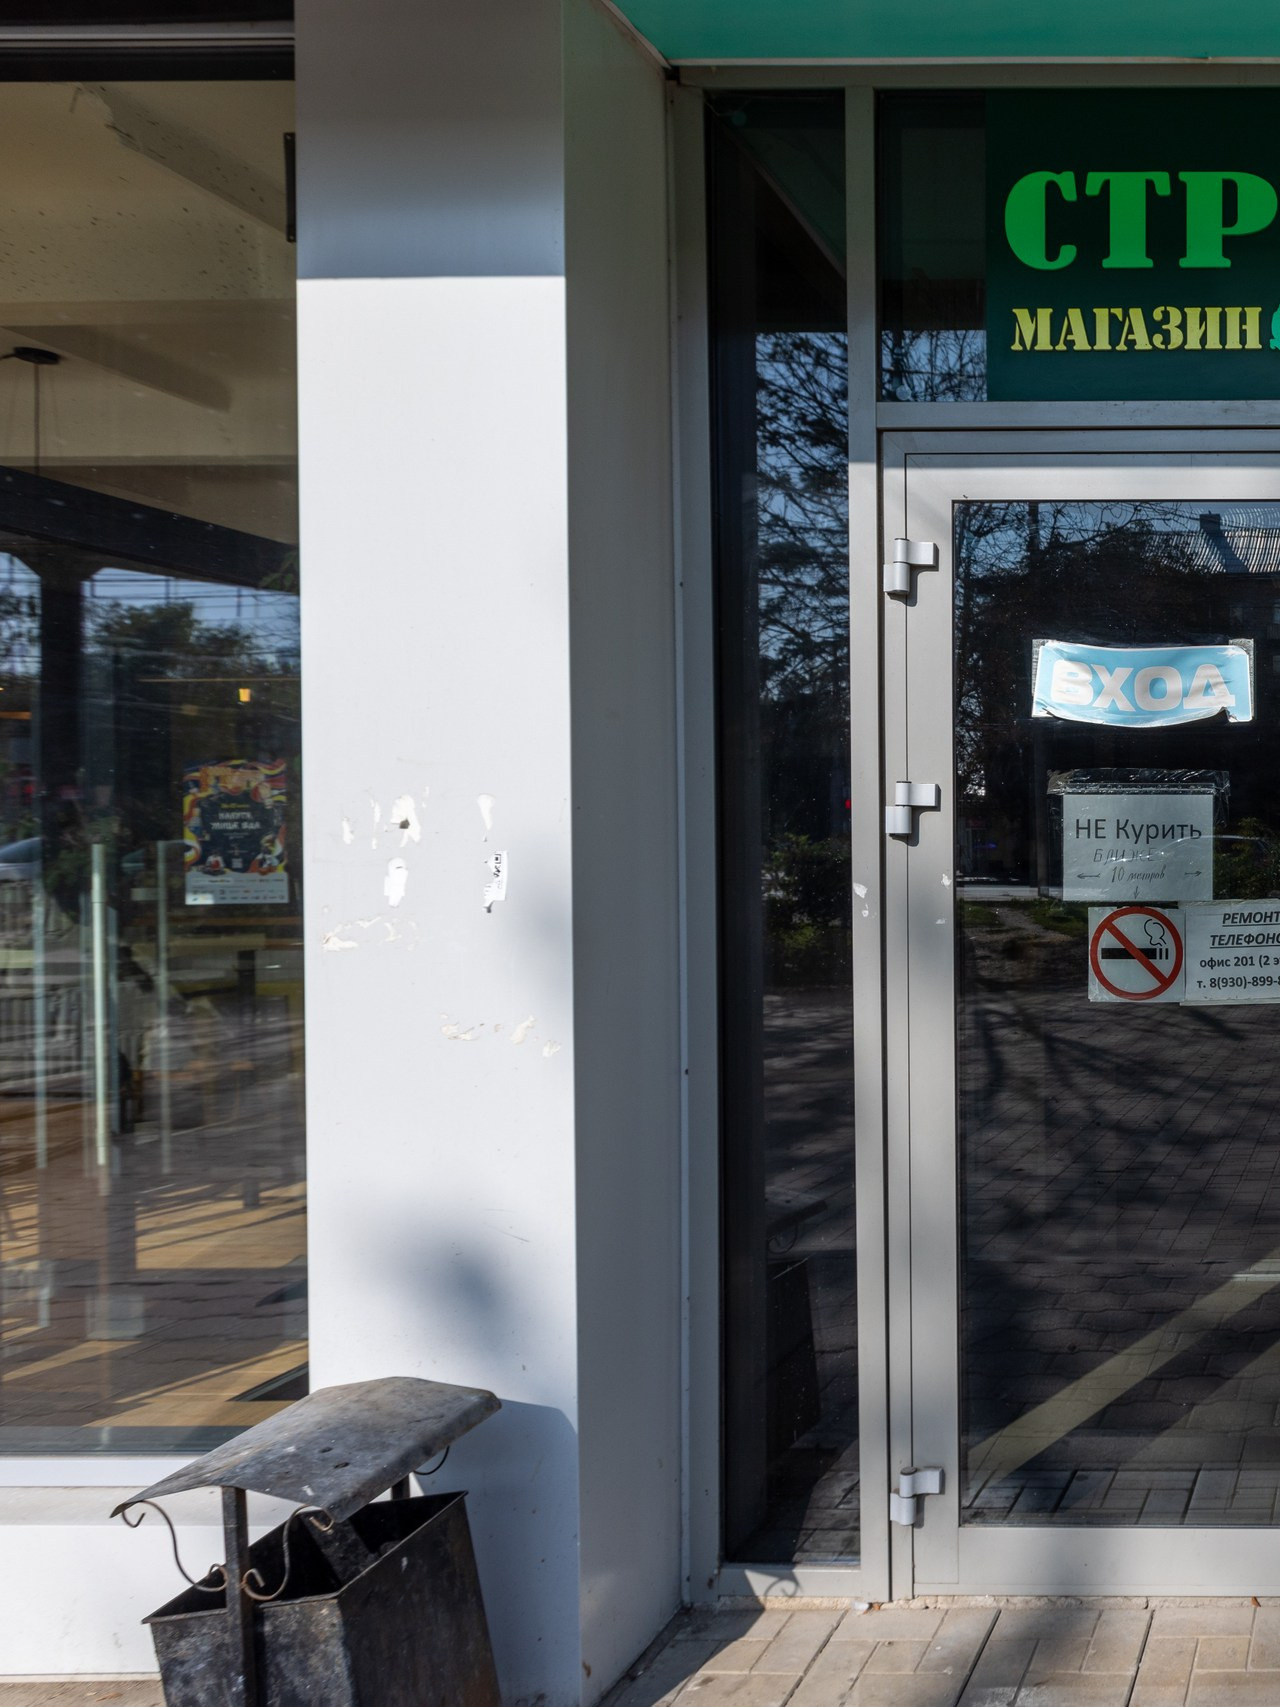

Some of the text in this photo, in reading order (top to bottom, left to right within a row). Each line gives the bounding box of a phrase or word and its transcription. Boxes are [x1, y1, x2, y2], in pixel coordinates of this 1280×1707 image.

[1010, 305, 1263, 351] МАГАЗИН
[1050, 659, 1236, 712] ВХОД
[1075, 818, 1202, 844] НЕ Курить
[1199, 956, 1231, 970] офис
[1233, 956, 1255, 967] 201
